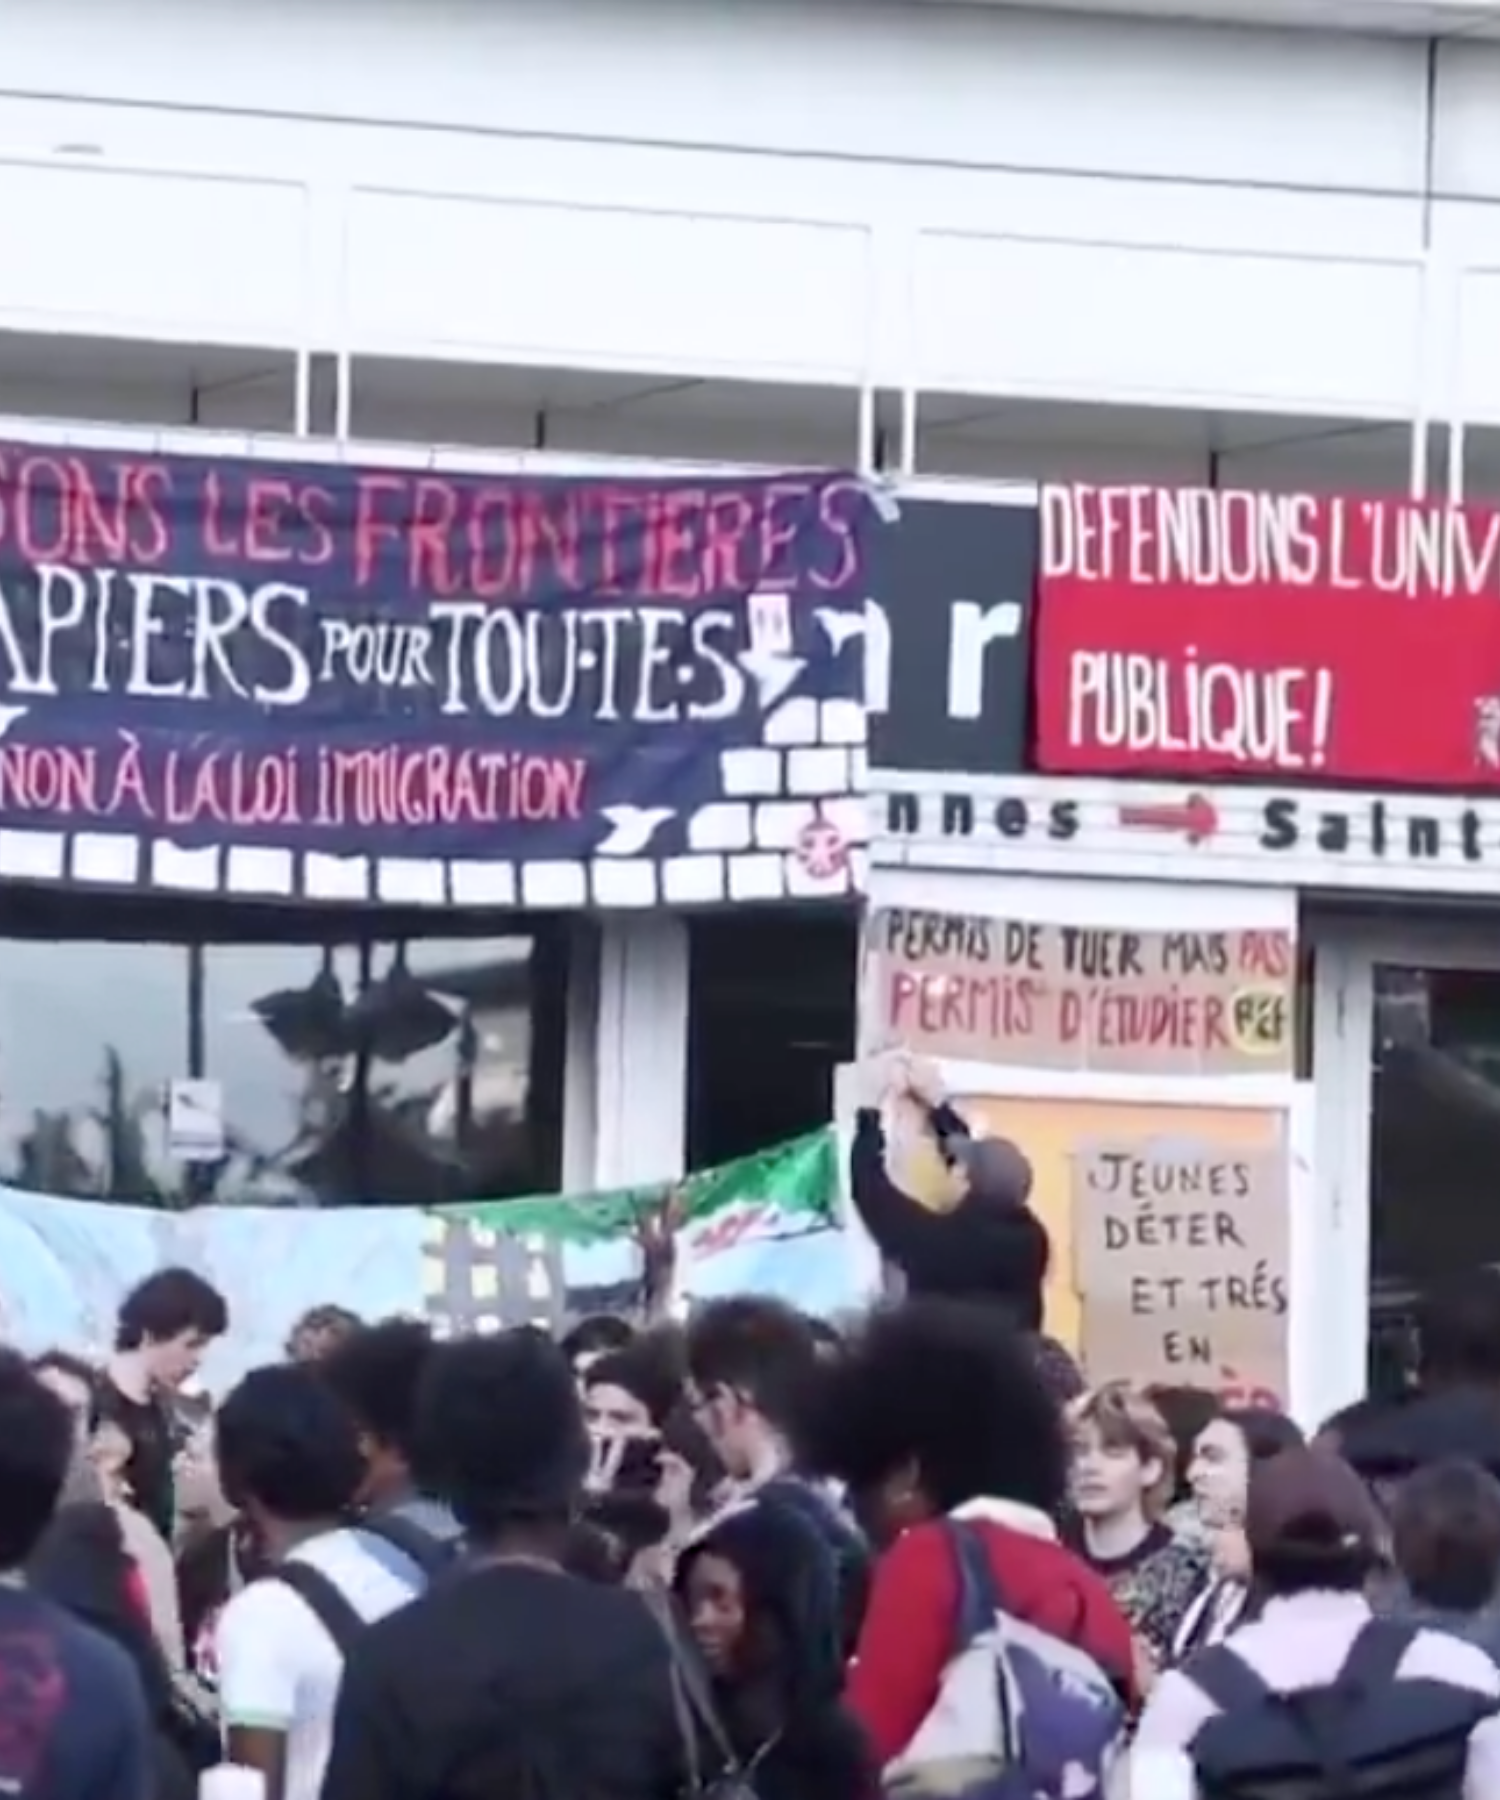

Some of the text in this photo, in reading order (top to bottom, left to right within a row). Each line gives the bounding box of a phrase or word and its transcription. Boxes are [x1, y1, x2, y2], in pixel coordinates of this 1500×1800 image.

[206, 468, 335, 565] LES
[1040, 484, 1319, 588] DEFENDONS
[318, 618, 436, 687] POUR
[103, 728, 156, 819] À
[1258, 798, 1482, 862] Saint
[1005, 920, 1043, 971] DE
[1059, 926, 1144, 979] TUER
[1090, 1152, 1251, 1198] JEUNES
[1103, 1202, 1247, 1250] DÉTER
[1130, 1276, 1182, 1316] ET
[1162, 1329, 1212, 1366] EN
